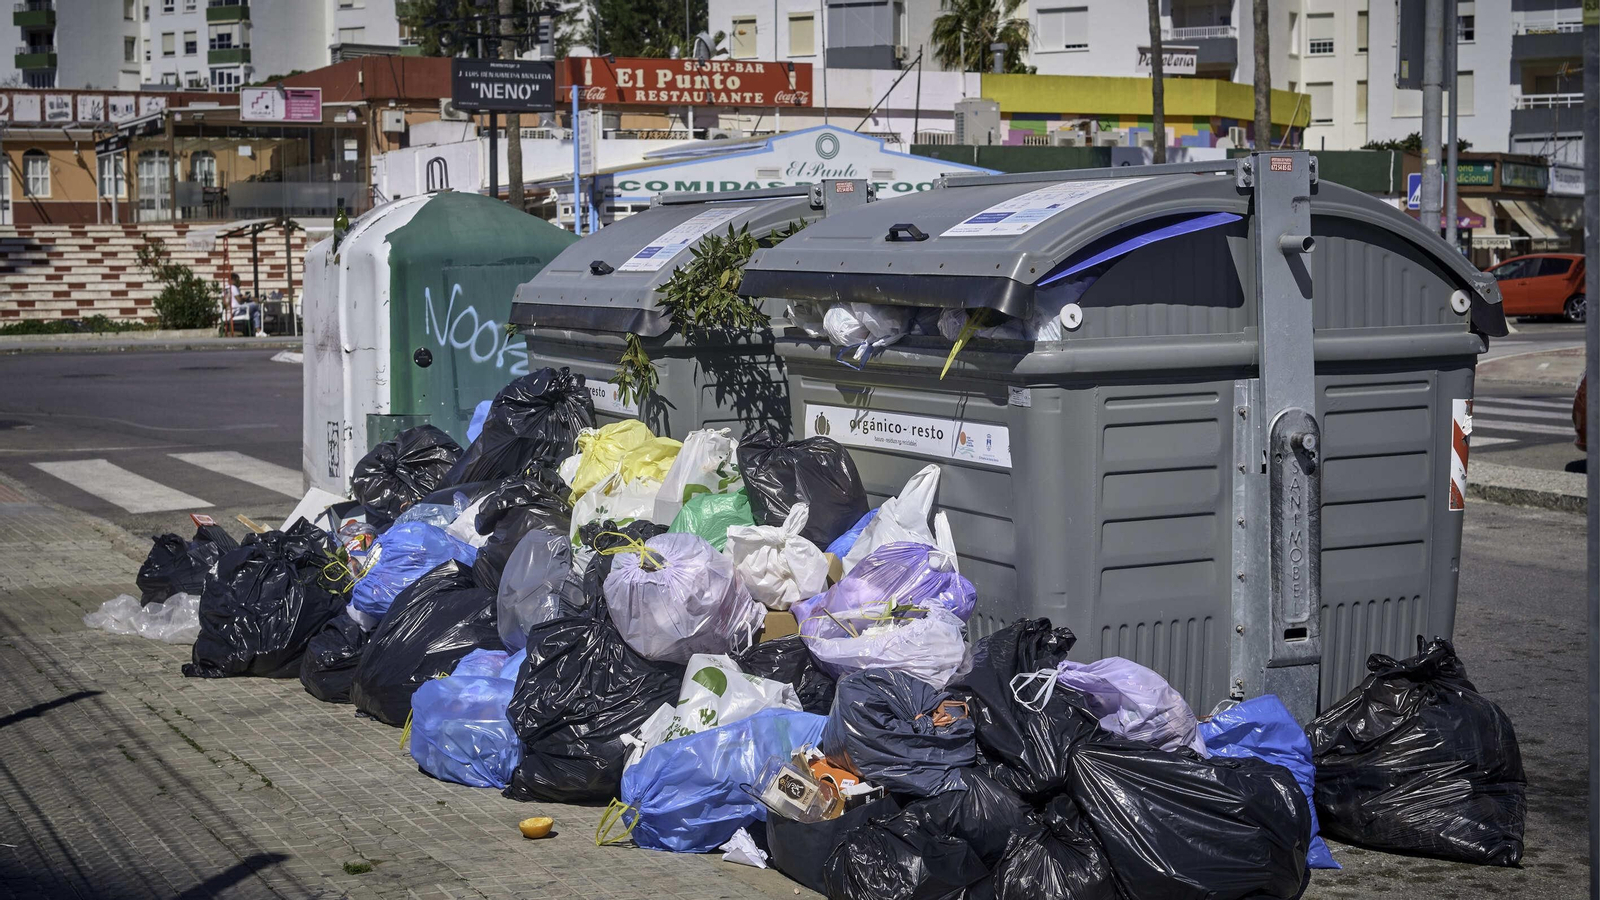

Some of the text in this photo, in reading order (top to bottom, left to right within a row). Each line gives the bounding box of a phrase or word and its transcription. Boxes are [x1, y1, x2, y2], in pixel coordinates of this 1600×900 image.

[684, 61, 765, 73] SPORT-BAR
[1138, 52, 1194, 67] Paelería
[616, 68, 741, 90] El Punto
[471, 82, 540, 100] "NENO"
[636, 90, 764, 103] RESTAURANTE
[786, 160, 857, 178] El Punto
[589, 386, 605, 398] esto
[912, 424, 944, 440] resto
